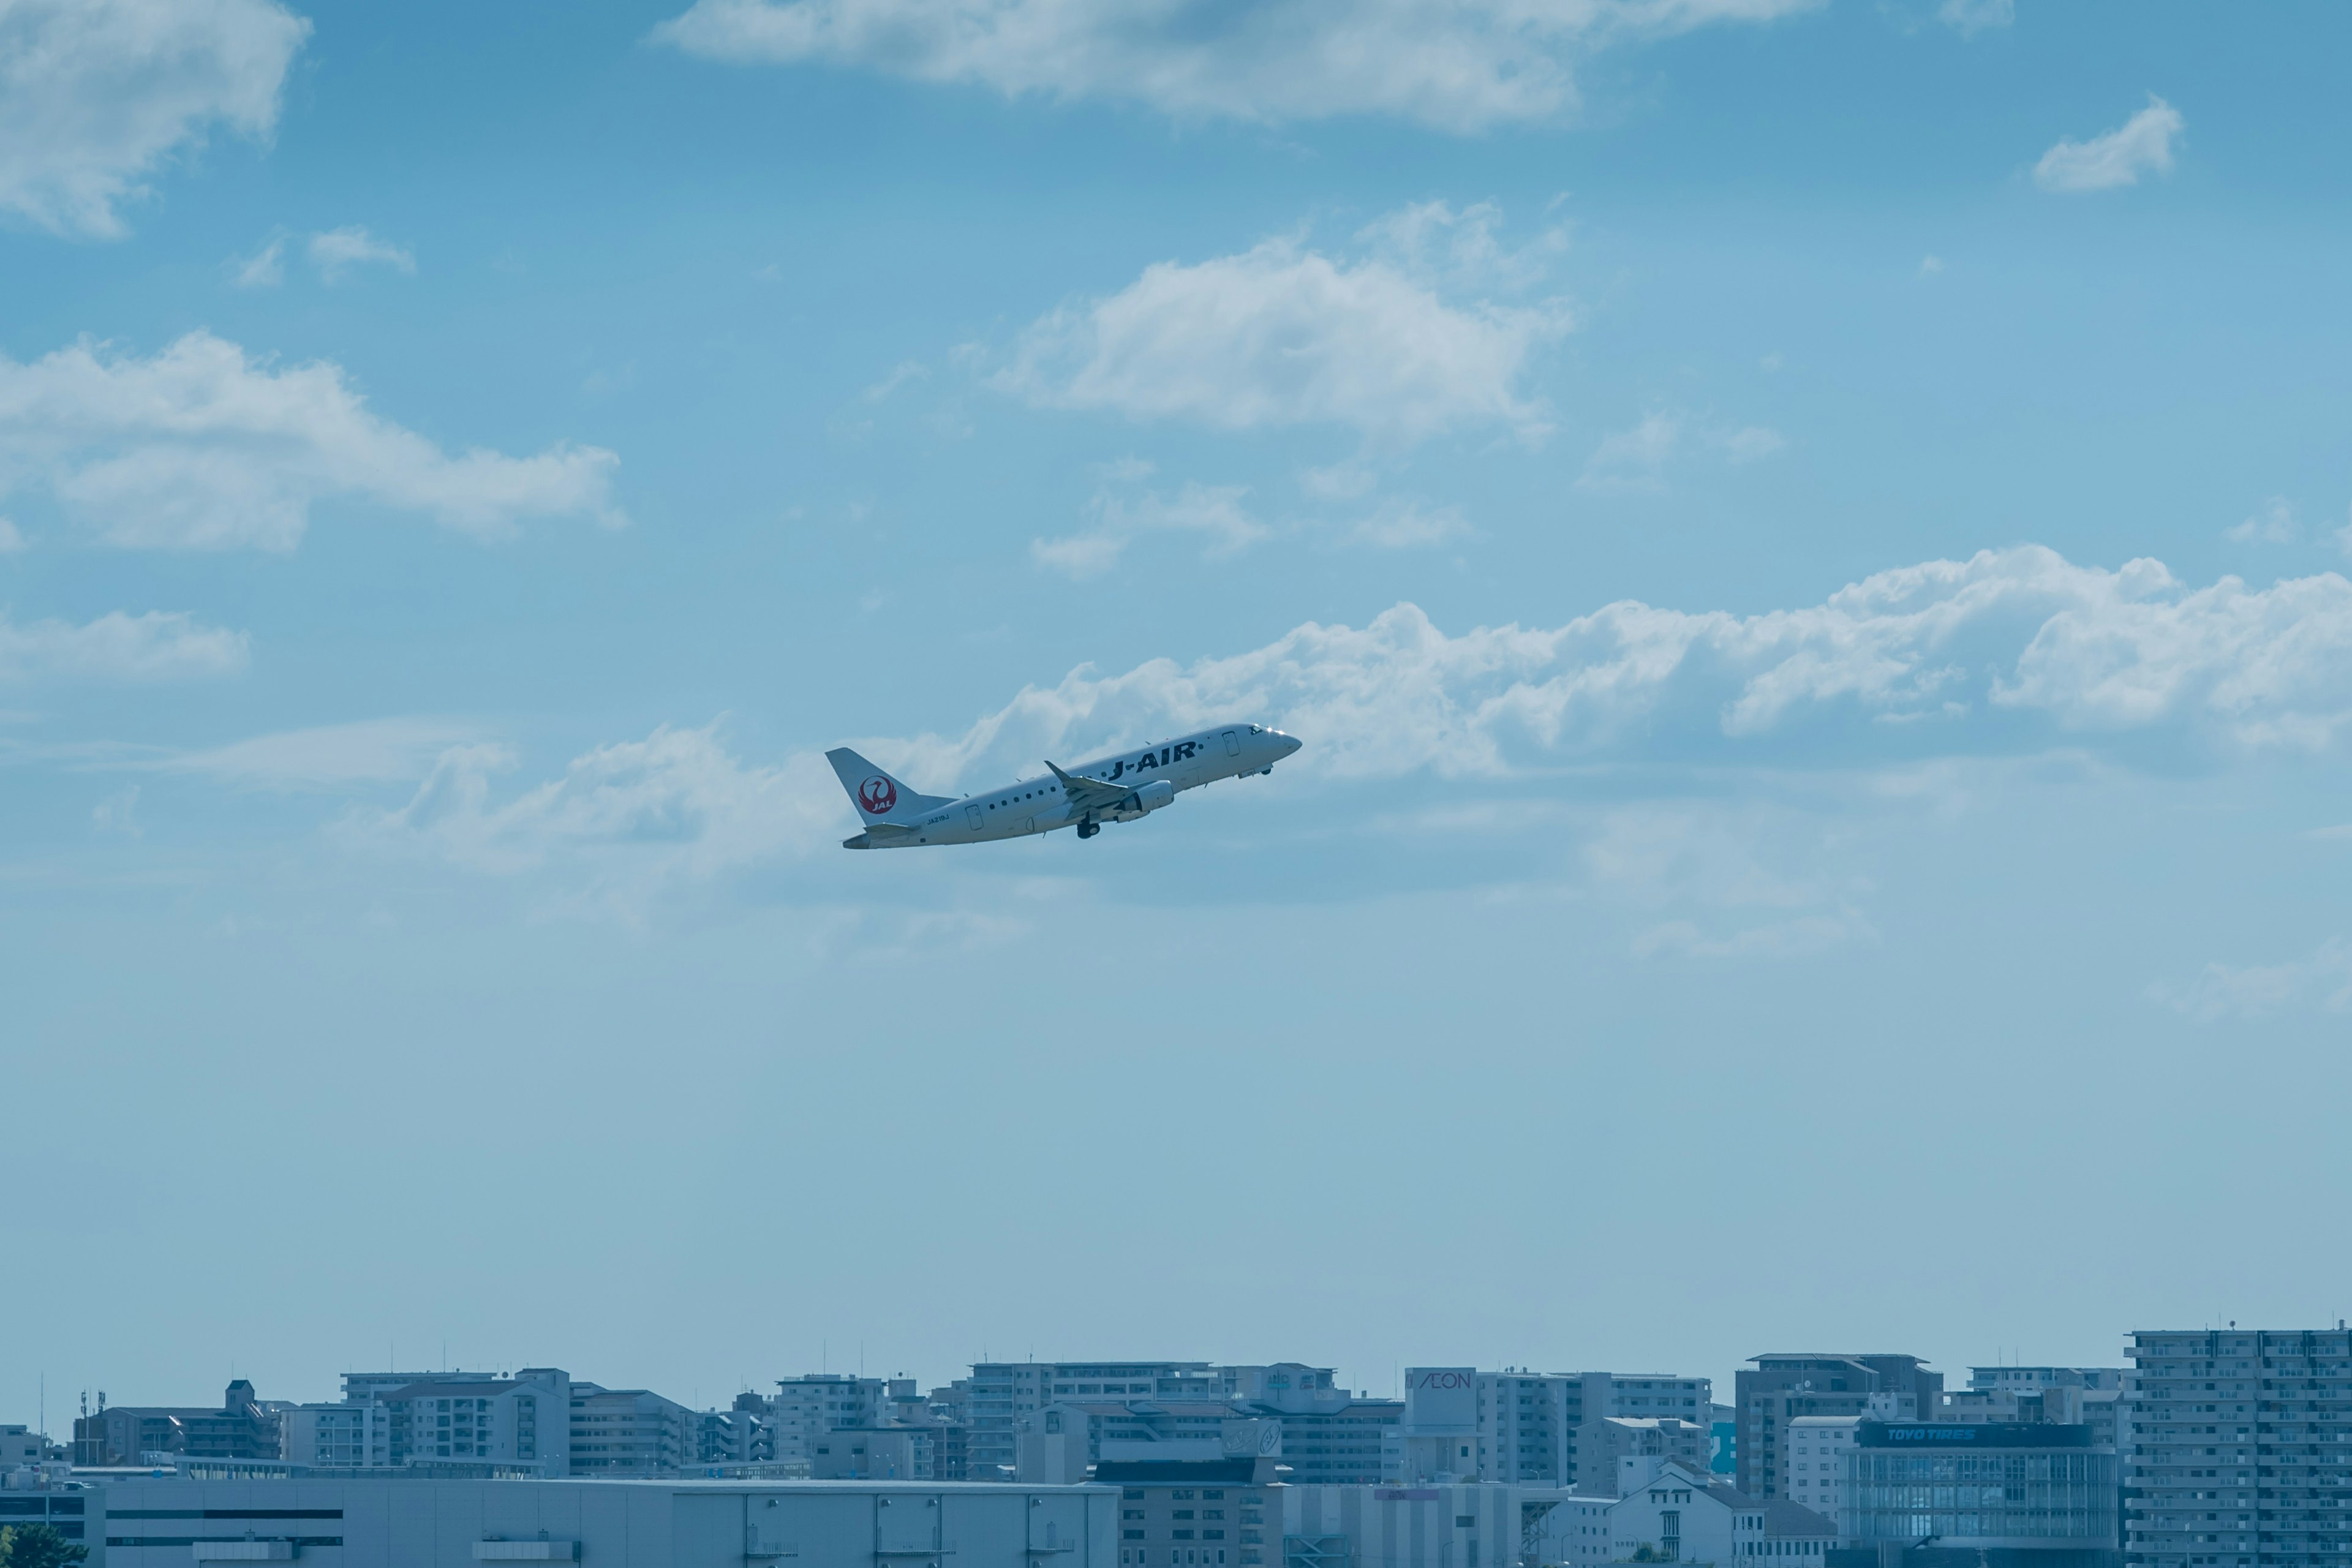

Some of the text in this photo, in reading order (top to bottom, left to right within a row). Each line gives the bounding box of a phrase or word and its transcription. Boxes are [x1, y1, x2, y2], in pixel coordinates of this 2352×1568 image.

[1108, 741, 1196, 782] J-AIR
[872, 800, 892, 812] JAL
[927, 814, 949, 825] JA219J
[1888, 1429, 1976, 1440] TOYO TIRES
